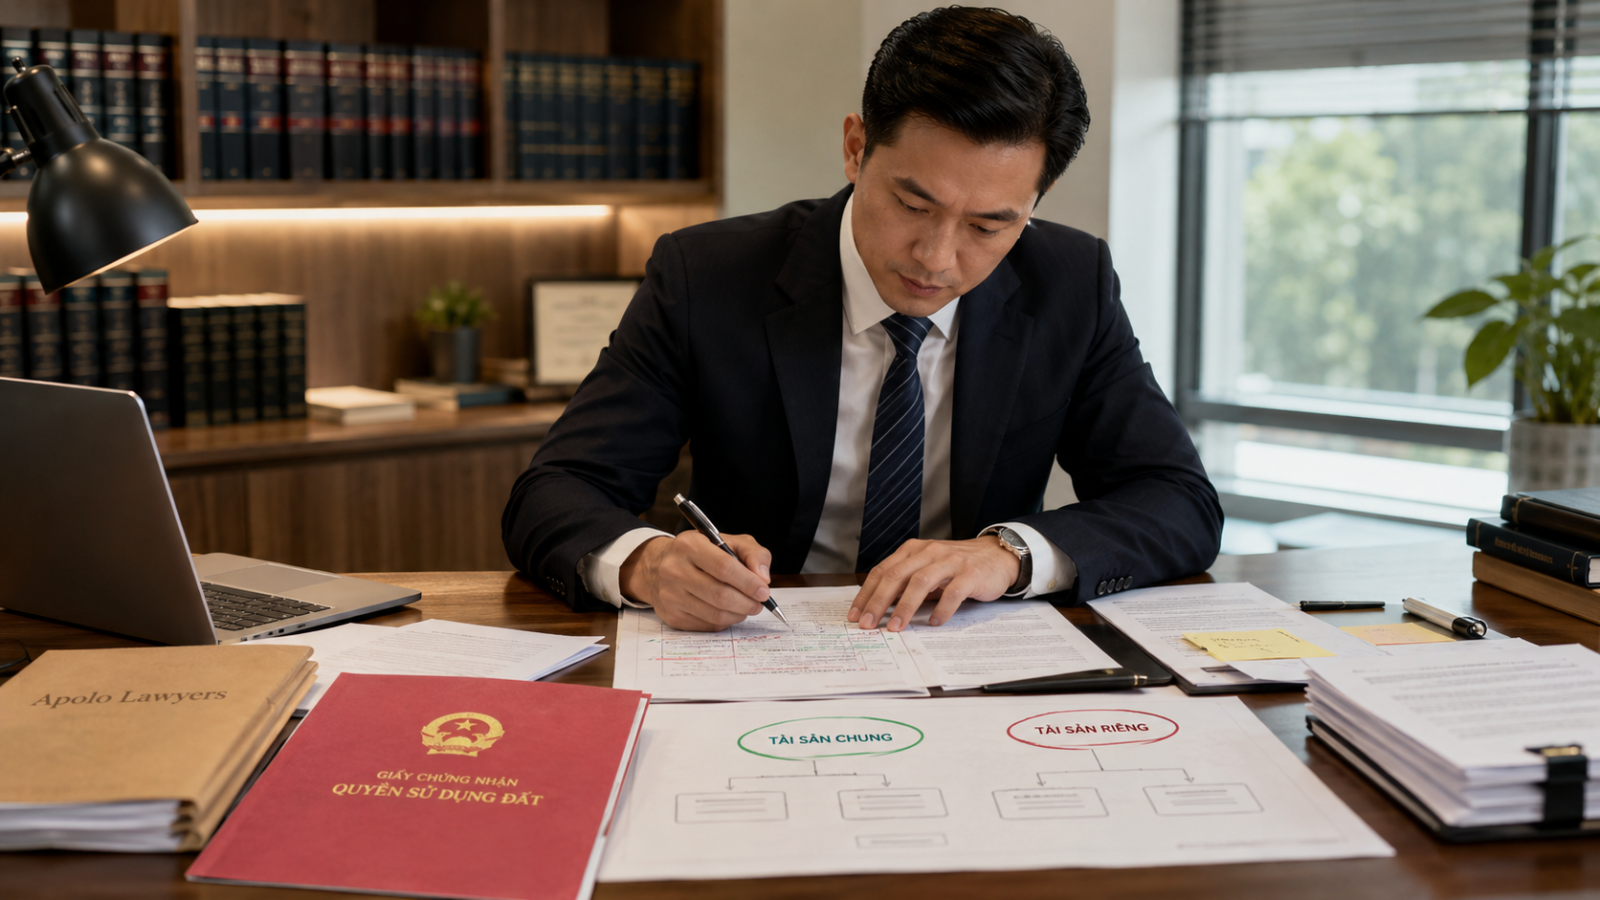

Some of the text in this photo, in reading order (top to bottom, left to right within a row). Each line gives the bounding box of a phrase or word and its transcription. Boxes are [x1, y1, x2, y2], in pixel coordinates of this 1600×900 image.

[30, 690, 229, 709] Apolo Lawyers
[1034, 724, 1061, 735] TÀI
[1100, 722, 1150, 733] RIÊNG
[768, 733, 794, 745] TÀI
[835, 733, 893, 743] CHUNG
[376, 768, 414, 781] GIẤY
[332, 781, 544, 806] QUYỀN SỬ DỤNG ĐẤT
